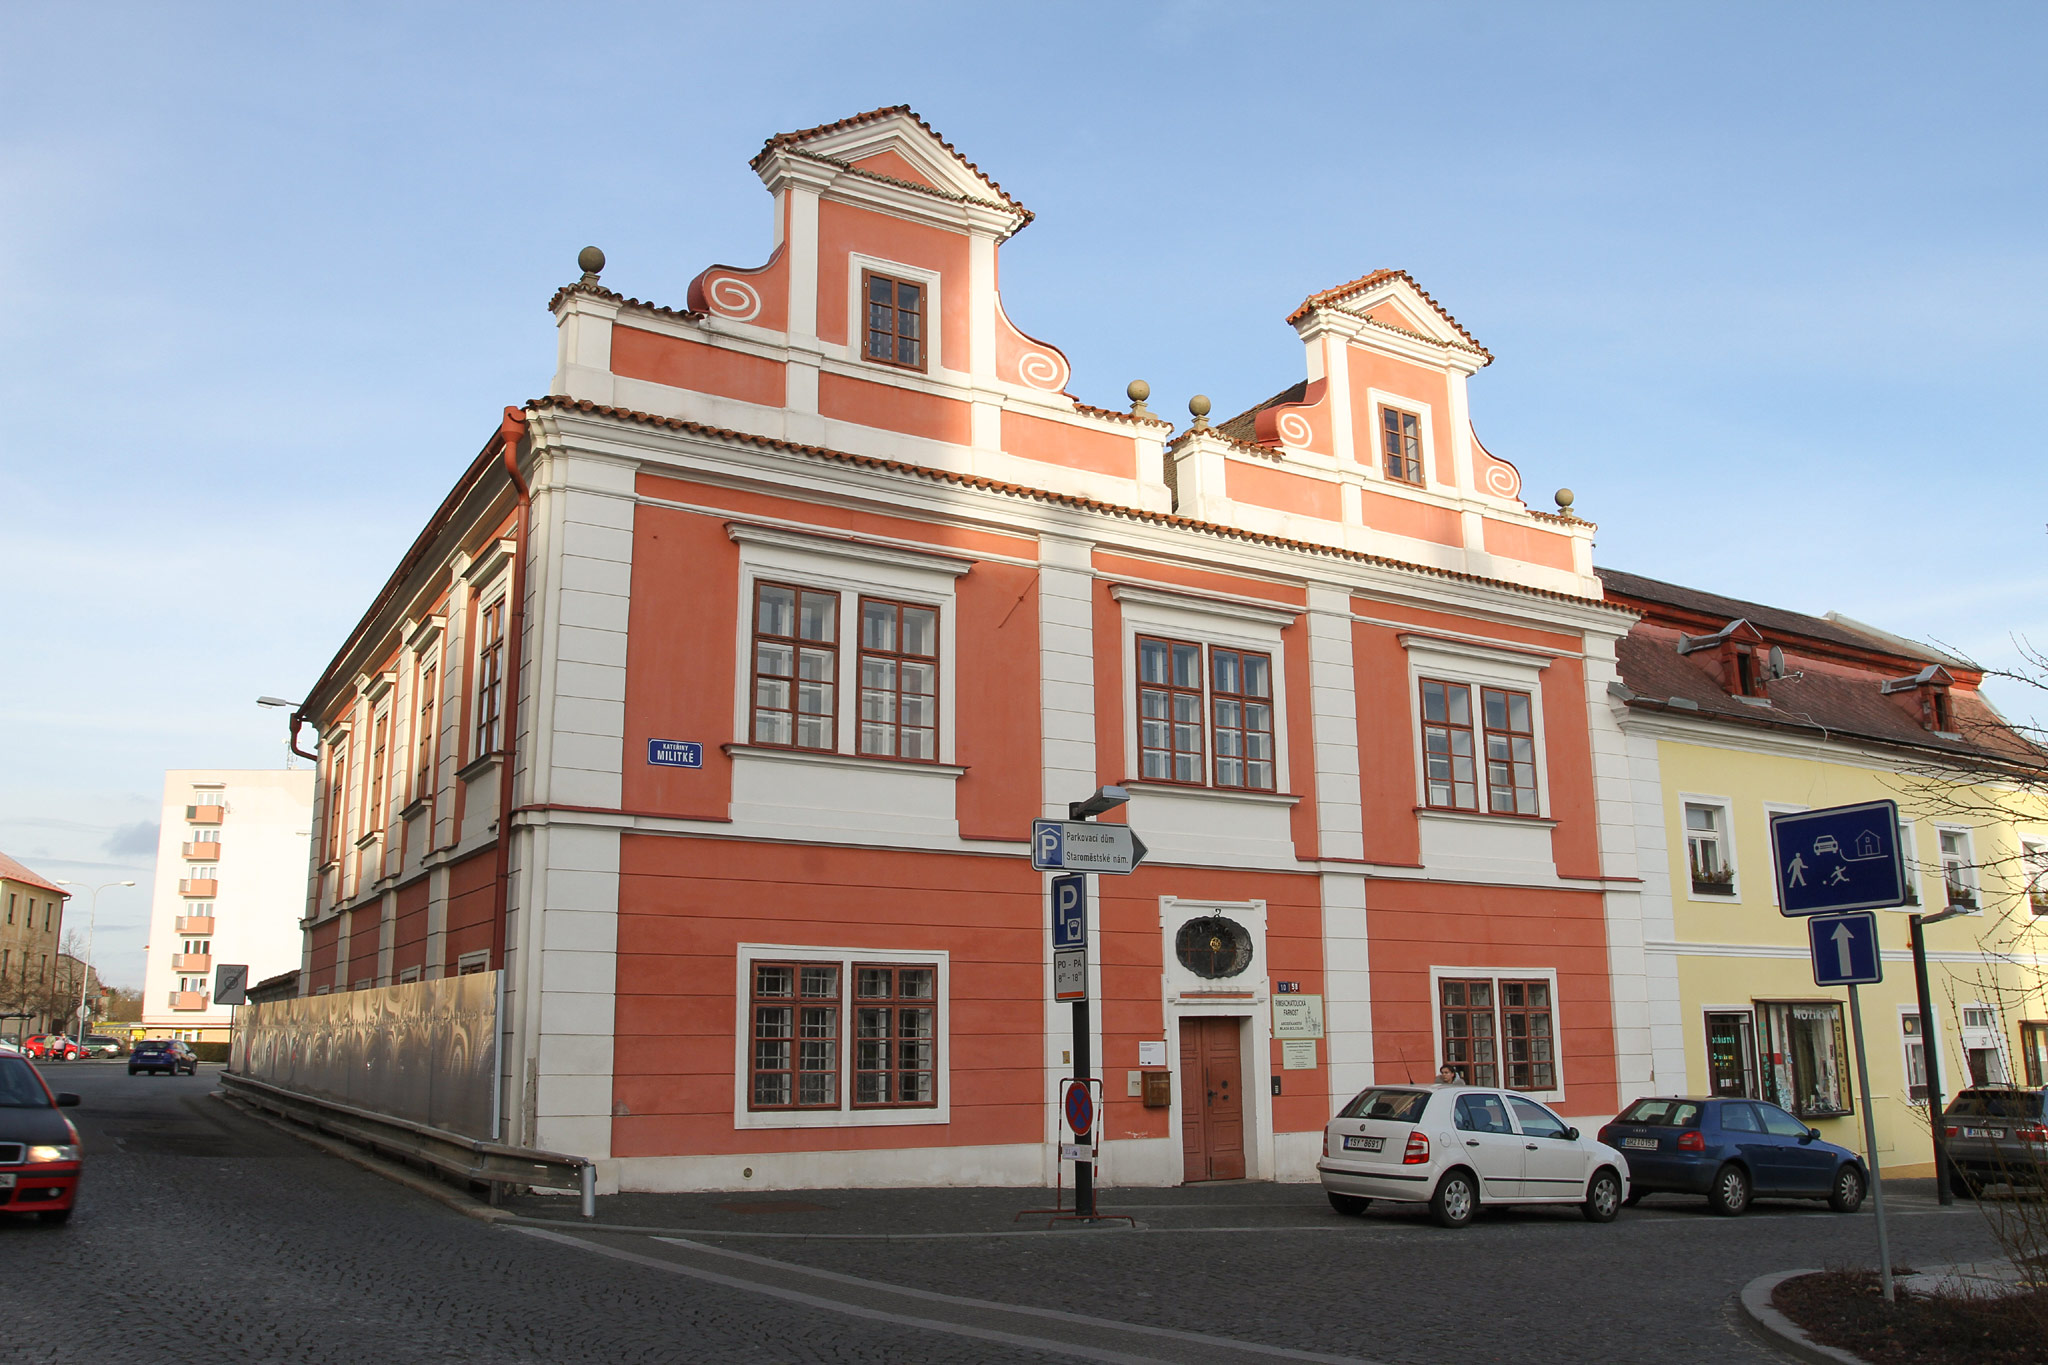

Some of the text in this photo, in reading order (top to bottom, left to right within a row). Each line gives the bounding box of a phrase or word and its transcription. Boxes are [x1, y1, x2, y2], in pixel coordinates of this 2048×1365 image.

[663, 743, 689, 751] KATEŘINY
[657, 750, 694, 763] MILITKÉ
[1066, 831, 1115, 844] Parkovací dům
[1042, 835, 1058, 860] P
[1066, 851, 1129, 864] Staroměstské nám.
[1059, 885, 1078, 925] P
[1057, 960, 1067, 969] PO
[1350, 1137, 1379, 1148] 1SY 8691
